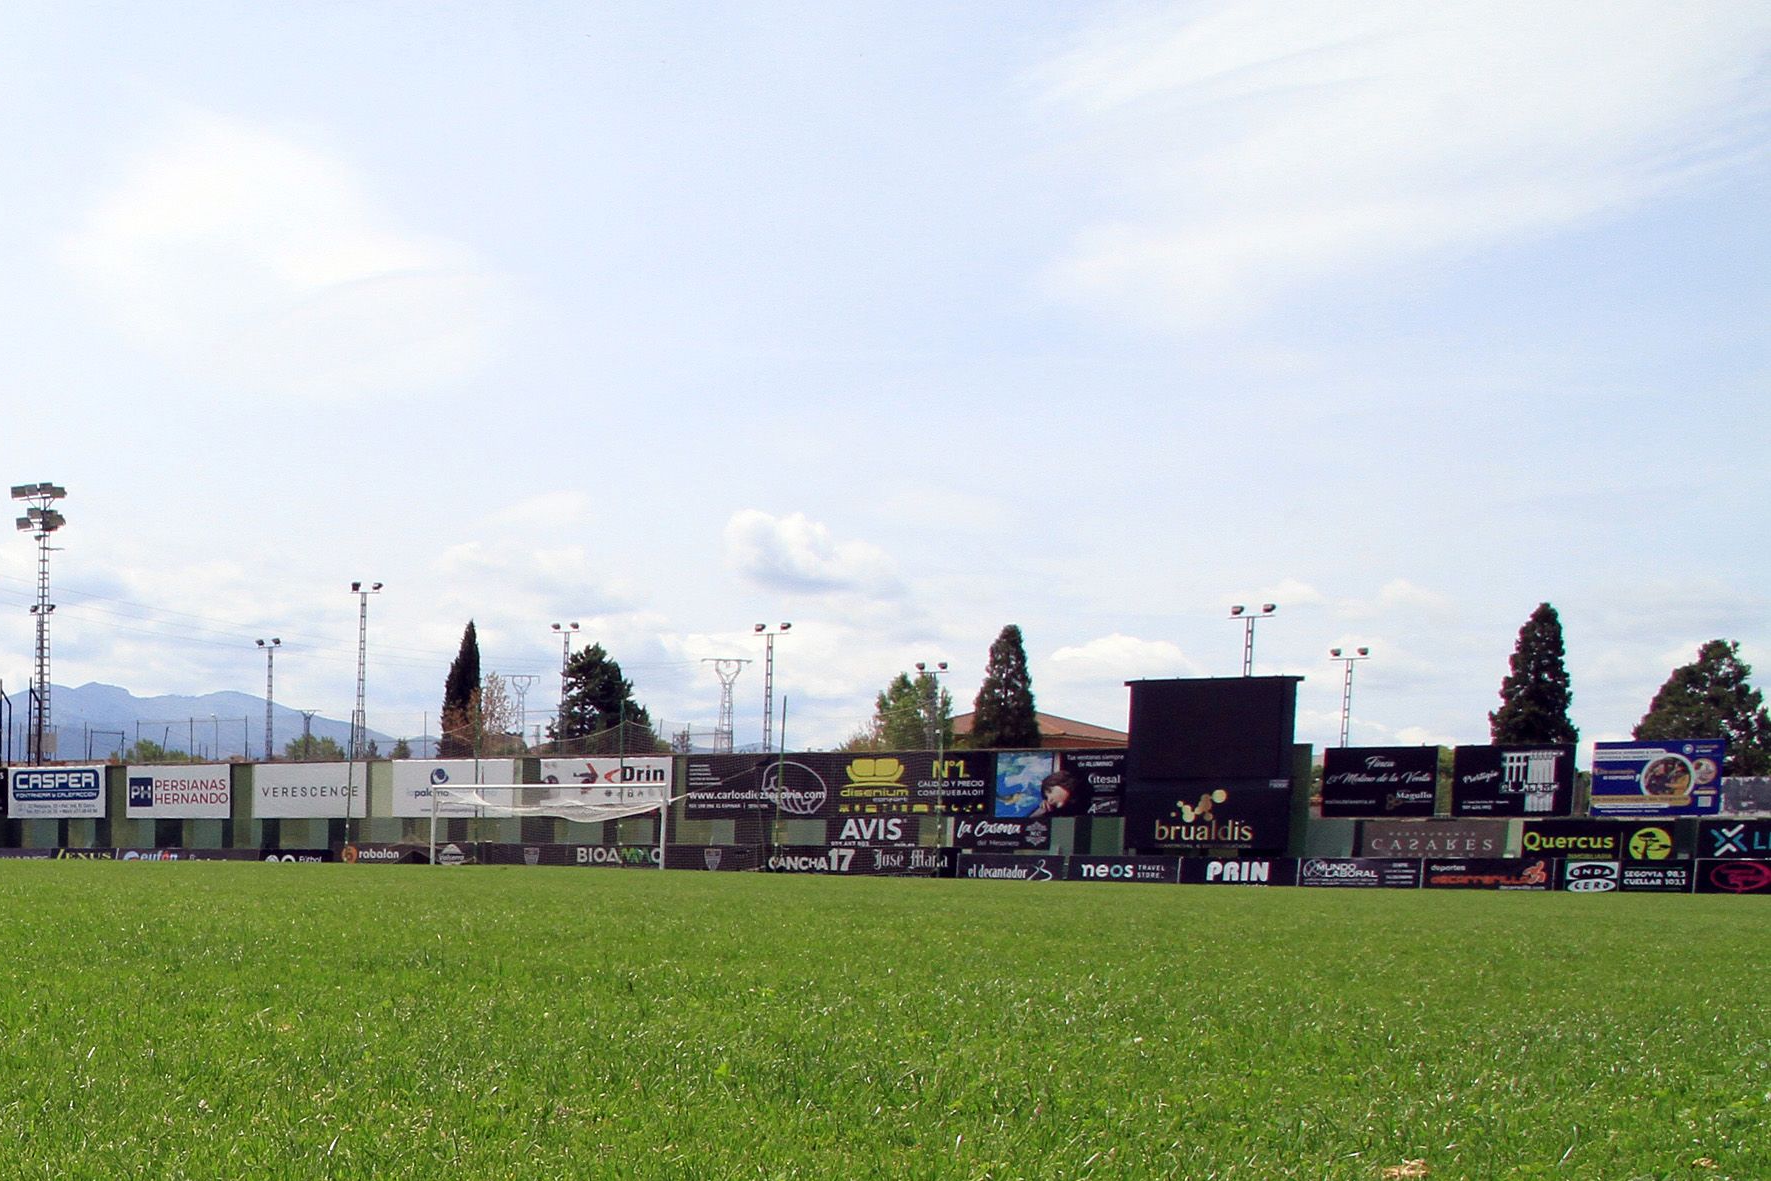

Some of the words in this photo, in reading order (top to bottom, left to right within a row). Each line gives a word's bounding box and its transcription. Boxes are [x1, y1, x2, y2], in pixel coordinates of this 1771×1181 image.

[622, 764, 664, 782] Drin
[155, 779, 226, 792] PERSIANAS
[262, 785, 359, 799] VERESCENCE
[131, 787, 152, 801] PH
[155, 792, 228, 806] HERNANDO
[1396, 791, 1432, 800] Magullo
[840, 818, 902, 840] AVIS
[974, 820, 1021, 837] Casona
[1155, 819, 1252, 841] brualdis
[1523, 831, 1614, 851] Quercus
[769, 855, 829, 871] CANCHA
[828, 848, 855, 871] 17
[874, 850, 904, 870] José
[908, 850, 948, 869] Mara
[968, 863, 977, 878] el
[978, 864, 1027, 879] decantador
[1081, 864, 1134, 878] neos
[1206, 861, 1269, 882] PRIN
[1325, 870, 1378, 878] LABORAL
[1431, 864, 1466, 872] deportes
[1624, 870, 1663, 878] SEGOVIA
[1574, 882, 1609, 890] CERO
[1624, 878, 1662, 886] CUELLAR
